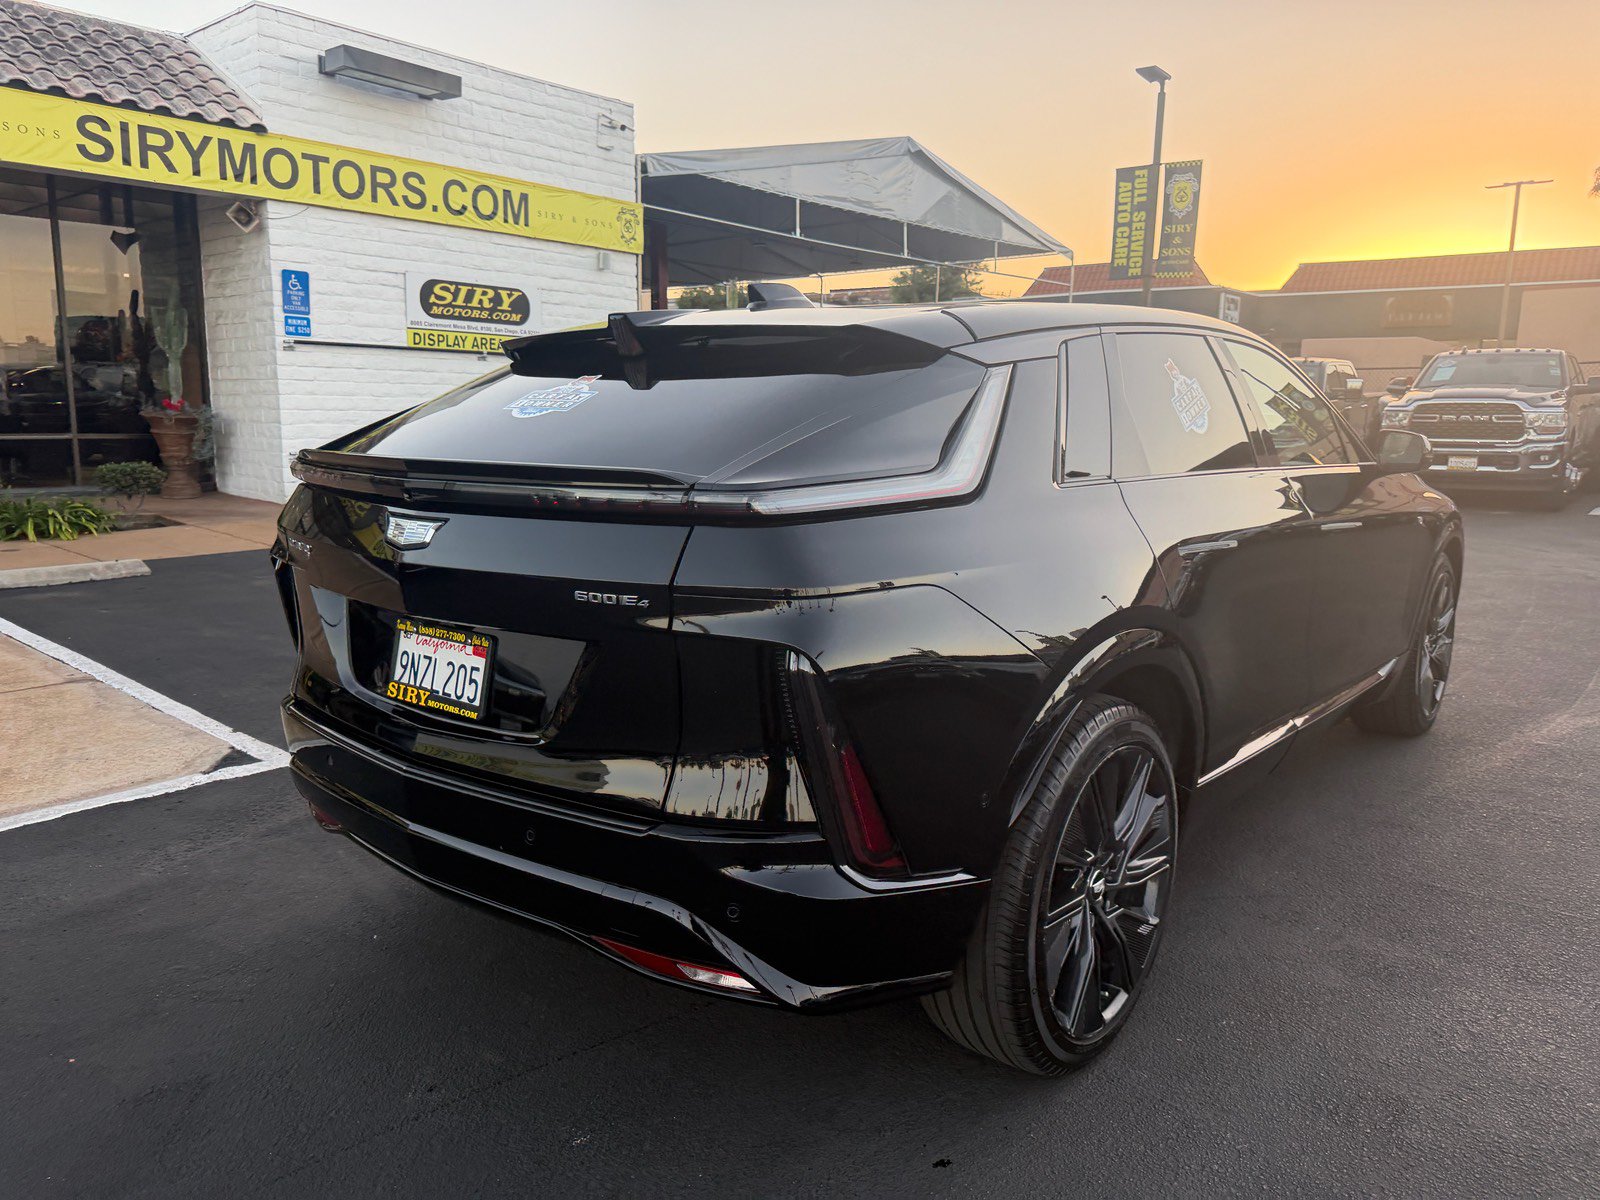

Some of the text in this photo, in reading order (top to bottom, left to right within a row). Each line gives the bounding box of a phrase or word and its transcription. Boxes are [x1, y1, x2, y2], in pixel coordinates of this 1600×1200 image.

[2, 121, 60, 140] SONS
[76, 114, 529, 227] SIRYMOTORS.COM
[1113, 181, 1132, 267] AUTO CARE
[1128, 169, 1148, 276] FULL SERVICE
[1164, 223, 1193, 234] SIRY
[1172, 236, 1182, 245] &
[1160, 247, 1191, 257] SONS
[429, 283, 522, 311] SIRY
[430, 306, 522, 322] MOTORS.COM
[424, 321, 451, 329] Clairemont
[413, 332, 467, 349] DISPLAY
[1441, 414, 1490, 422] RAM
[436, 628, 466, 643] 277-7300
[397, 650, 480, 704] 9NZL205
